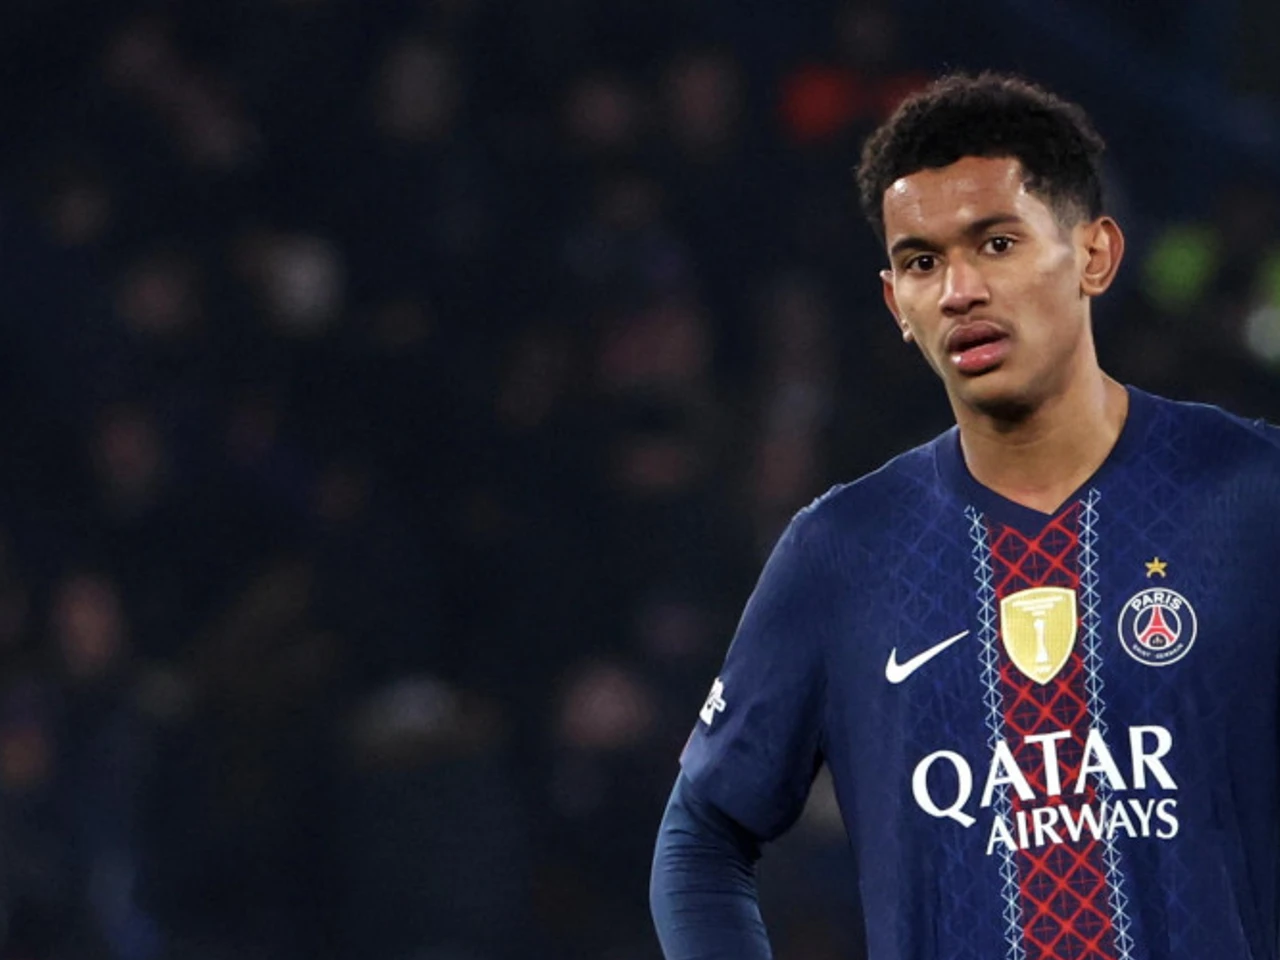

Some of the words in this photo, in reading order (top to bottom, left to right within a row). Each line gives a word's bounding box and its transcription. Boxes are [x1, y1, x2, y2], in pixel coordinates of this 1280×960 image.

[1131, 592, 1182, 611] PARIS
[912, 725, 1178, 828] QATAR
[986, 799, 1179, 855] AIRWAYS
